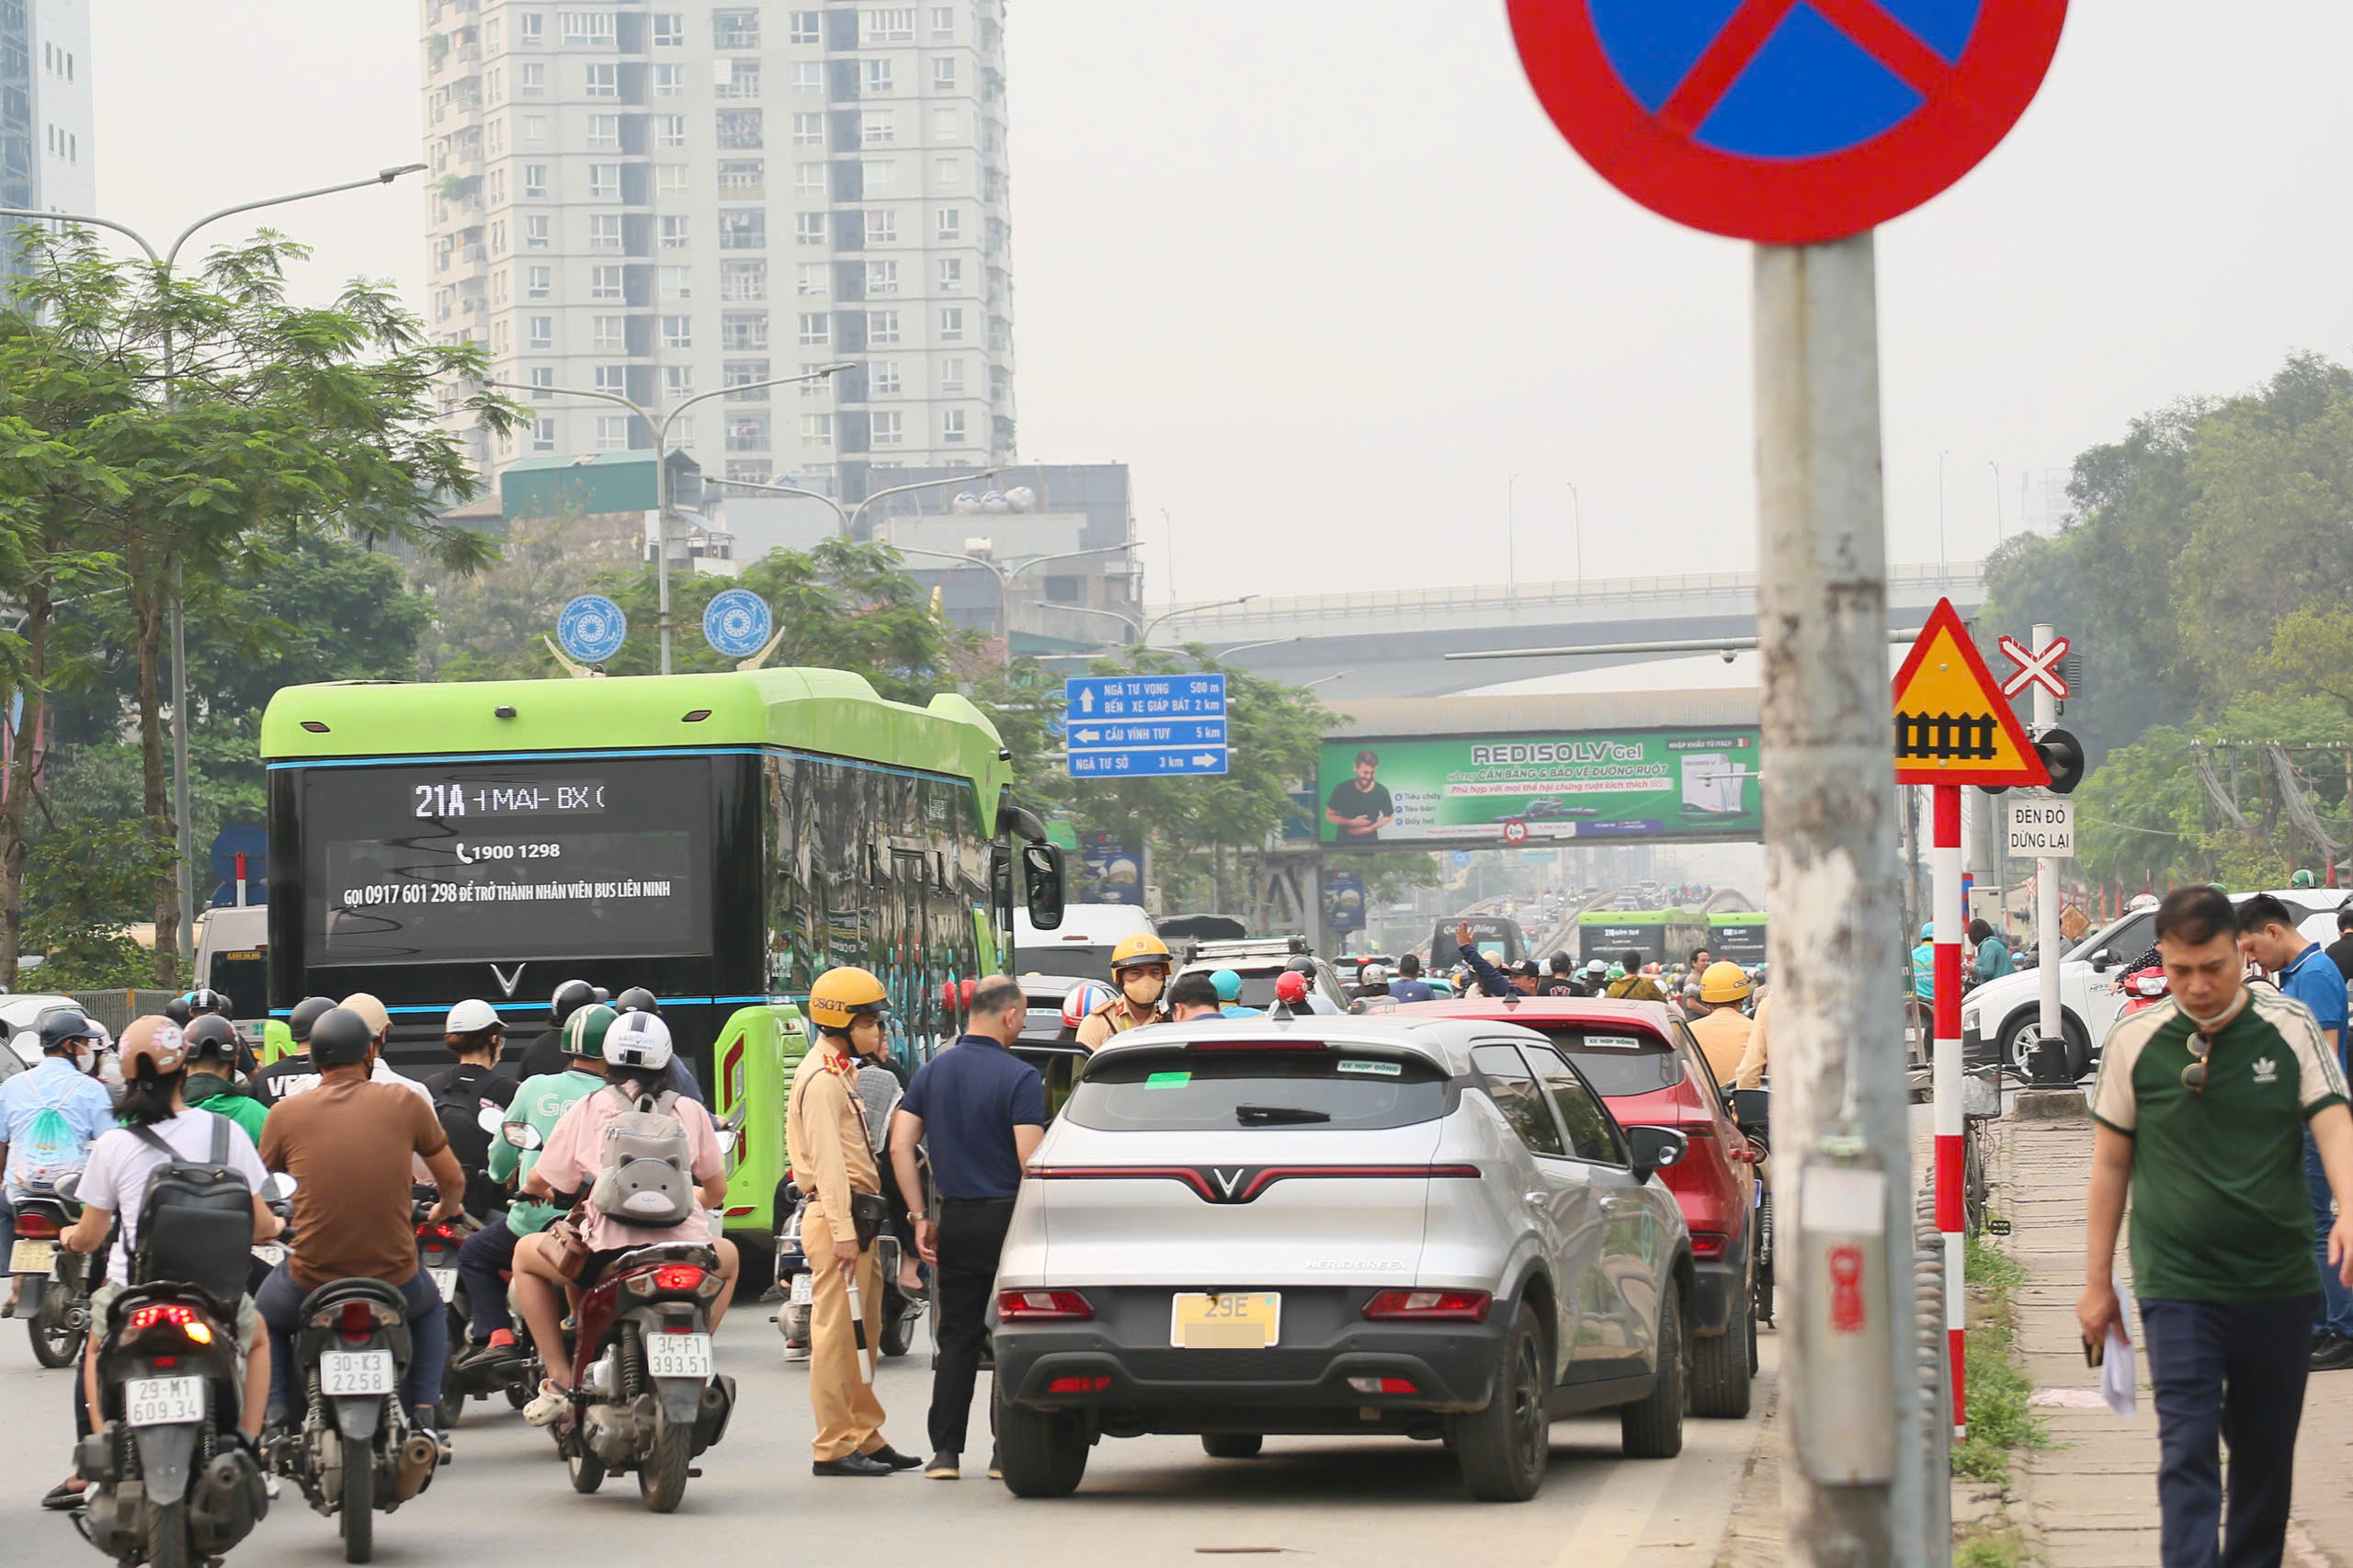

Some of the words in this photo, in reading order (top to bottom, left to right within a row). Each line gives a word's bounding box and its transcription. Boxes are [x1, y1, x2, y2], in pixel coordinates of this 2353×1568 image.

[1104, 682, 1123, 696] NGÃ
[1127, 683, 1141, 695] TƯ
[1143, 682, 1169, 697] VỌNG
[1189, 681, 1207, 694] 500
[1210, 684, 1220, 693] m
[1104, 698, 1124, 713] BẾN
[1132, 700, 1144, 712] XE
[1147, 697, 1169, 711] GIÁP
[1172, 697, 1190, 710] BÁT
[1195, 699, 1201, 710] 2
[1204, 699, 1220, 710] km
[1105, 726, 1124, 741] CẦU
[1127, 726, 1149, 740] VĨNH
[1153, 727, 1171, 739] TUY
[1196, 727, 1202, 738] 5
[1205, 726, 1221, 738] km
[1472, 743, 1608, 765] REDISOLV
[1611, 743, 1643, 761] Gel
[1075, 756, 1096, 770] NGÃ
[1099, 756, 1112, 769] TƯ
[1159, 756, 1165, 767] 3
[1168, 756, 1184, 767] km
[1478, 767, 1502, 779] CÂN
[1539, 769, 1547, 778] &
[1550, 765, 1573, 778] BẢO
[1592, 764, 1633, 777] ĐƯỜNG
[1636, 763, 1667, 776] RUỘT
[415, 784, 465, 817] 21A
[558, 786, 589, 810] BX
[2016, 805, 2041, 824] ĐÈN
[2045, 804, 2065, 824] ĐỎ
[2011, 830, 2046, 847] DỪNG
[2050, 833, 2069, 849] LẠI
[472, 845, 514, 860] 1900
[518, 843, 561, 858] 1298
[344, 889, 363, 908] GỌI
[365, 884, 400, 904] 0917
[402, 883, 427, 903] 601
[431, 882, 457, 903] 298
[459, 881, 473, 902] ĐỂ
[474, 881, 496, 902] TRỞ
[496, 881, 534, 901] THÀNH
[535, 881, 566, 900] NHÂN
[567, 880, 593, 899] VIÊN
[595, 882, 616, 898] BUS
[618, 878, 641, 897] LIÊN
[642, 881, 671, 897] NINH
[813, 997, 845, 1012] CSGT
[1205, 1296, 1249, 1317] 29E
[658, 1336, 700, 1354] 34-F1
[333, 1355, 381, 1372] 30-K3
[654, 1356, 708, 1373] 393.51
[333, 1374, 381, 1392] 2258
[133, 1403, 198, 1422] 609.34
